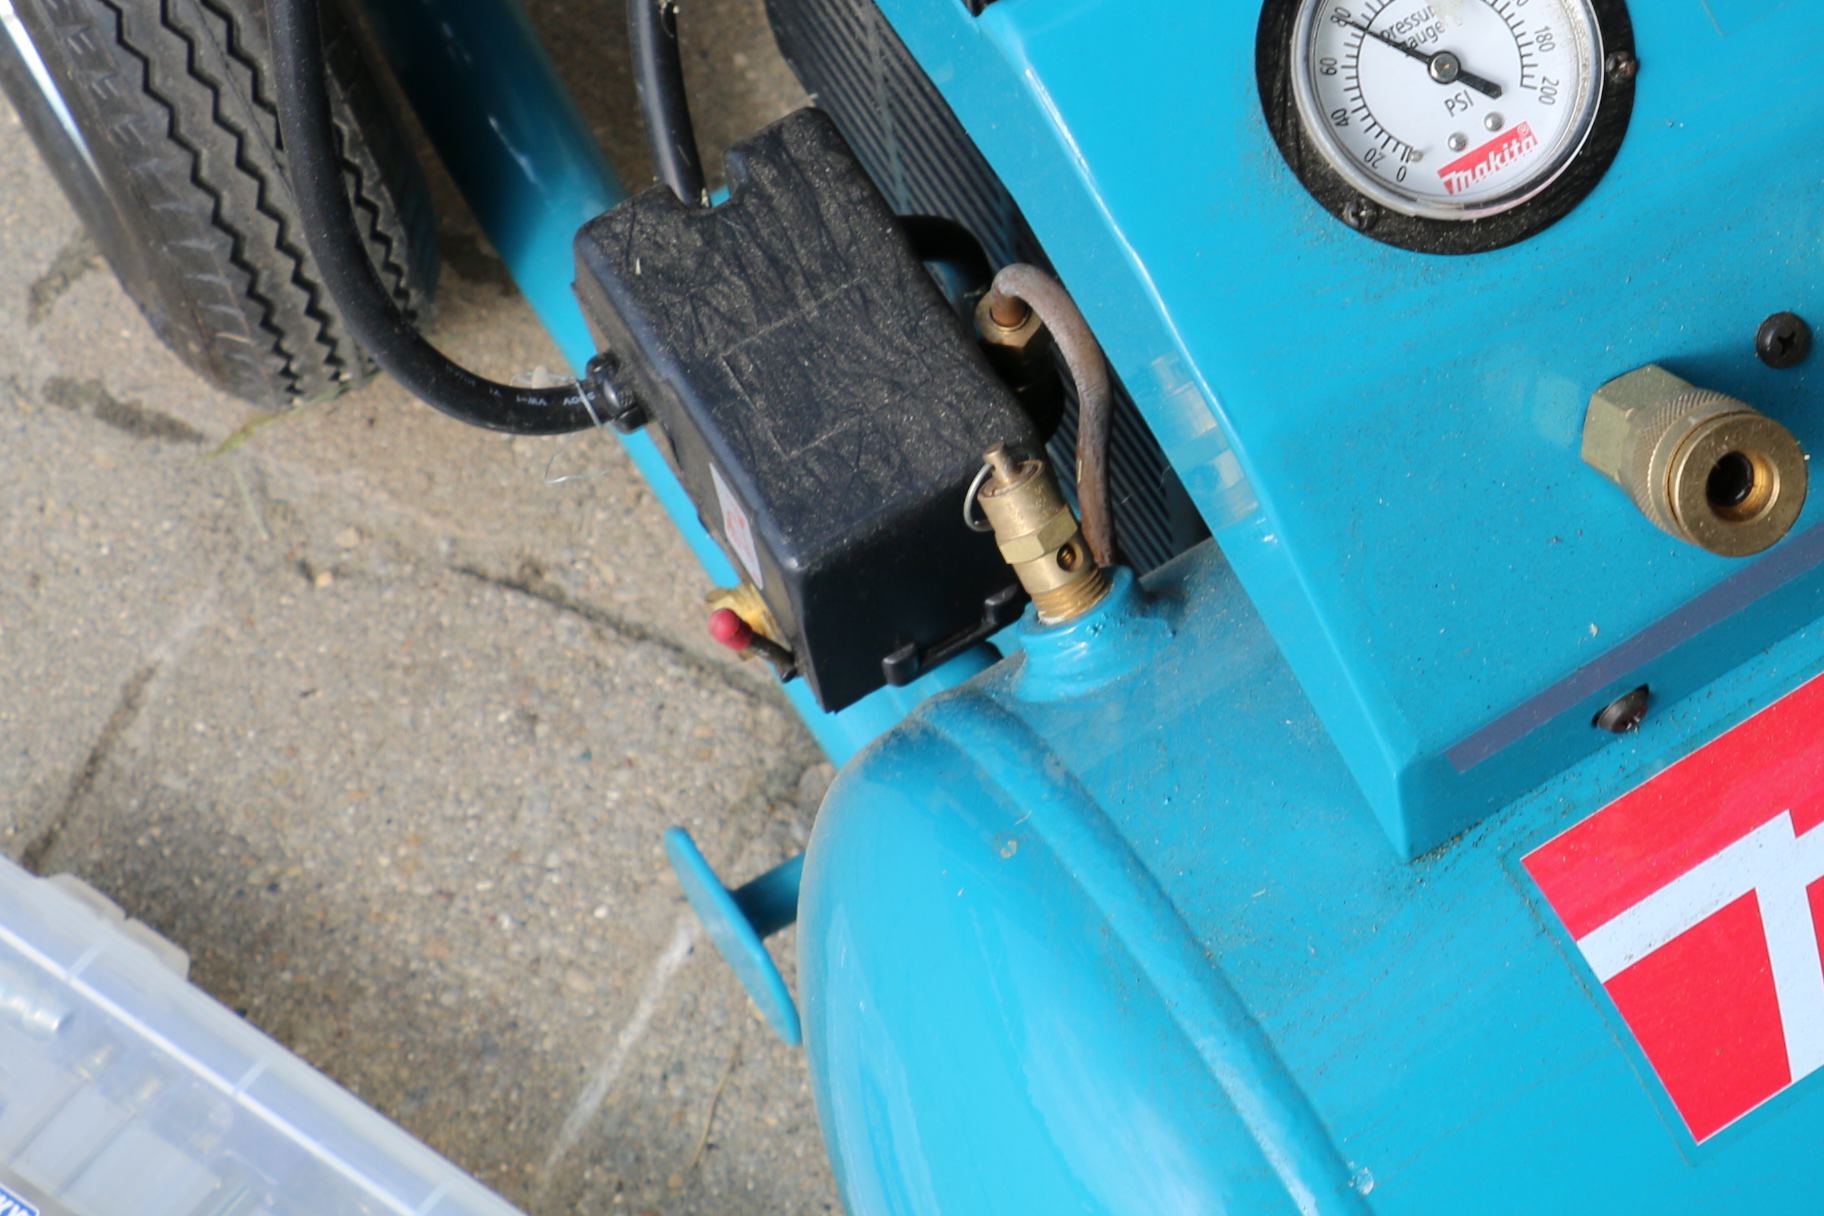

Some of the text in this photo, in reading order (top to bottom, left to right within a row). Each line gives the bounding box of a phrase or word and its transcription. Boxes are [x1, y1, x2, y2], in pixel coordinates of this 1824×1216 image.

[1533, 25, 1555, 53] 180
[1320, 57, 1338, 76] 60
[1539, 76, 1559, 106] 200
[1444, 90, 1474, 117] PSI
[1330, 108, 1350, 127] 40
[1365, 149, 1383, 169] 20
[1441, 136, 1538, 195] makita
[1397, 167, 1407, 182] 0
